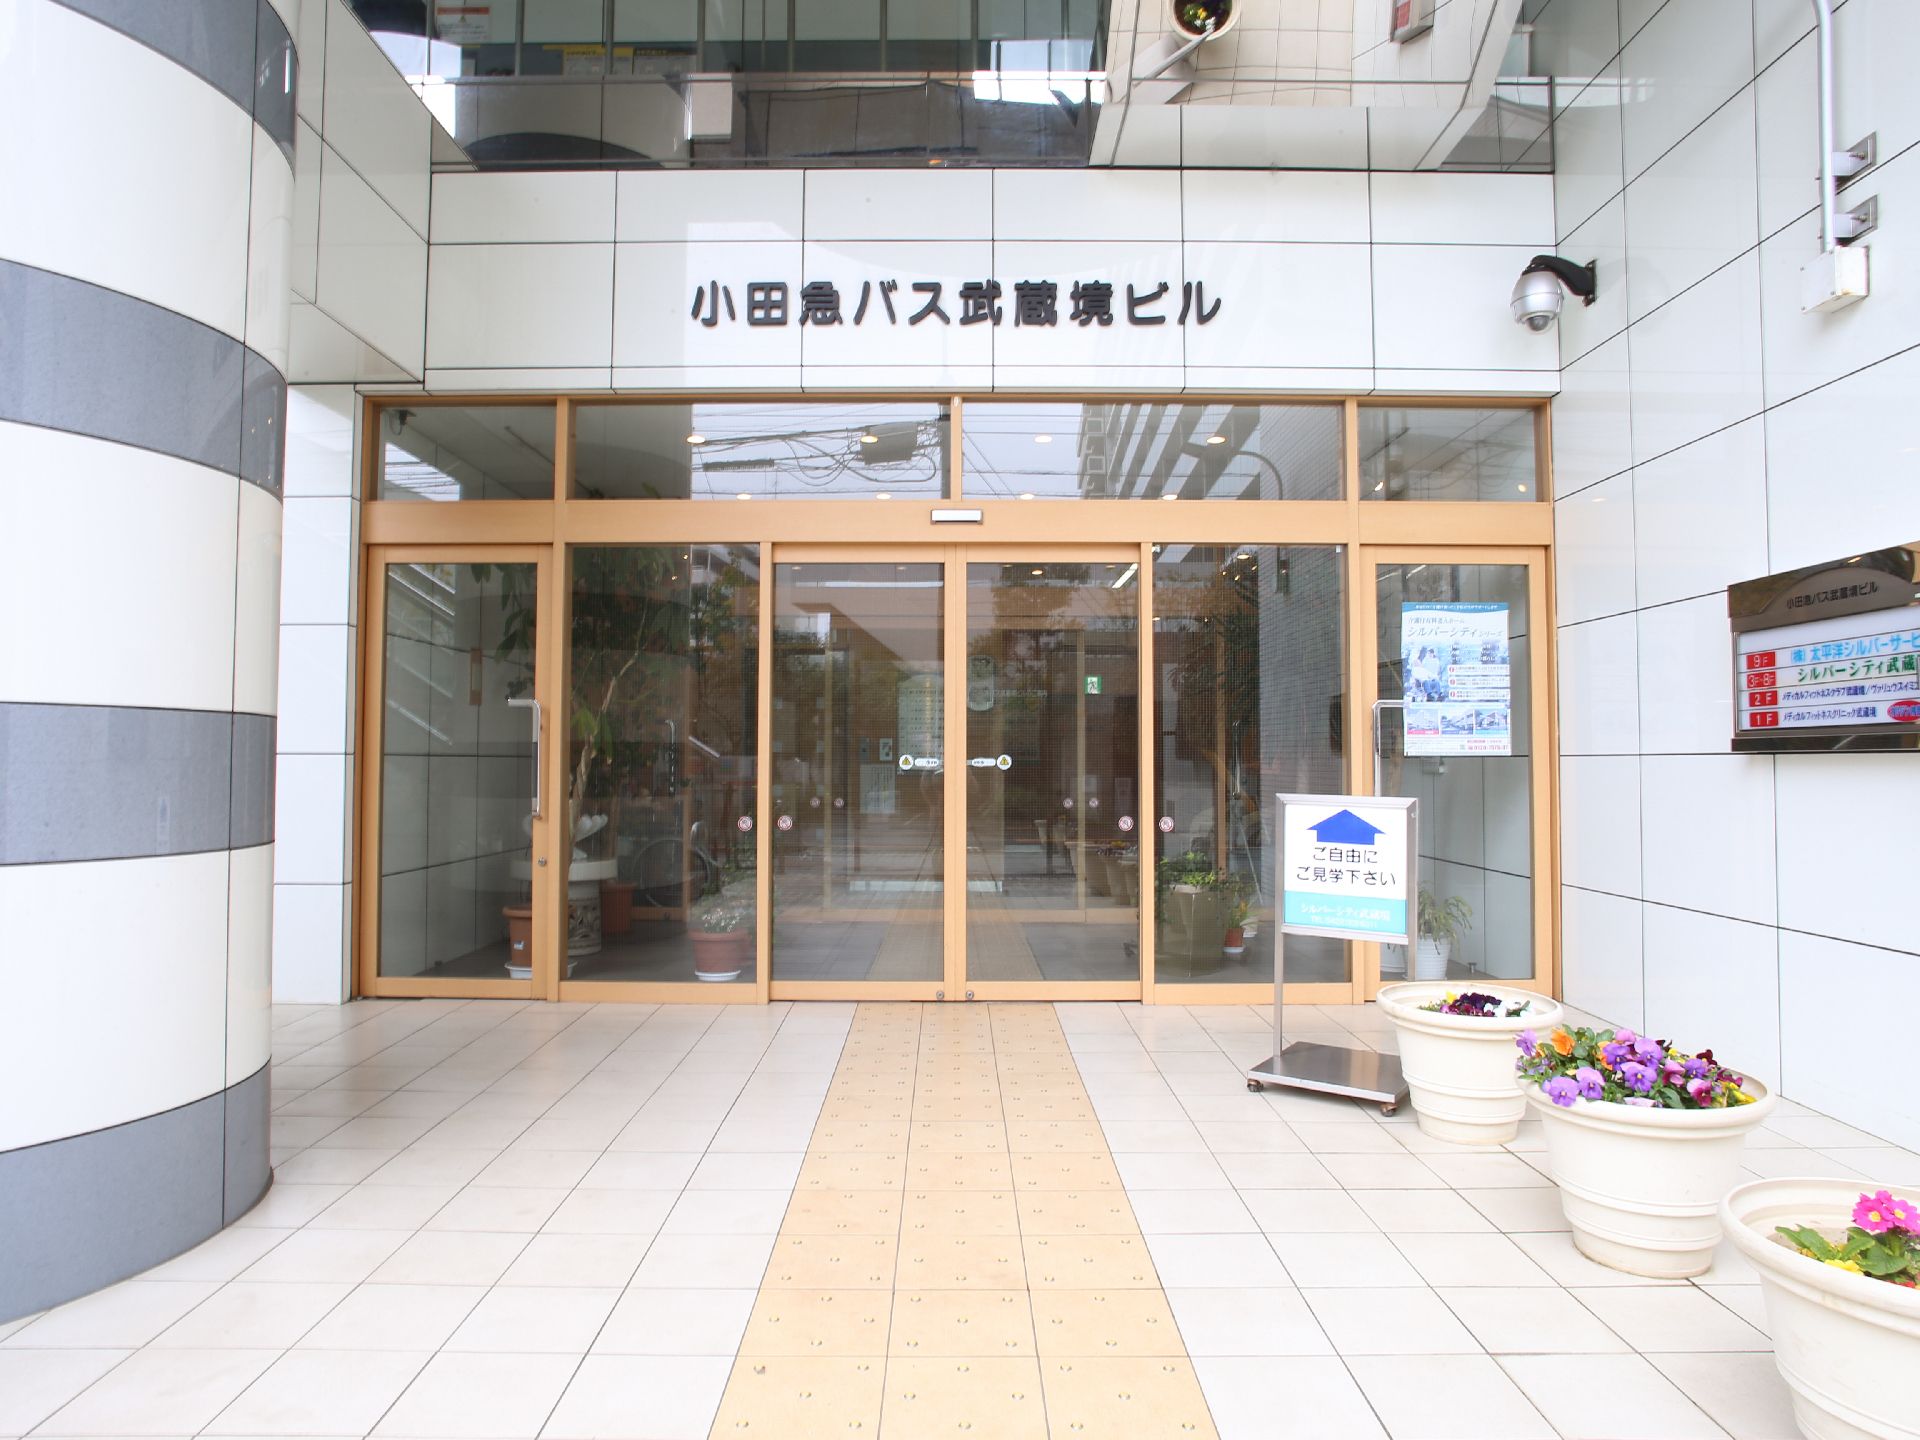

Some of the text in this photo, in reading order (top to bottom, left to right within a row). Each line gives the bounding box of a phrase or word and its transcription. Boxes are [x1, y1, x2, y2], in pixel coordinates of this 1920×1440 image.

[691, 280, 1222, 327] 小田急バス武蔵境ビル
[1753, 655, 1768, 668] 9F
[1754, 693, 1772, 705] 2F
[1756, 713, 1773, 726] 1F
[1313, 847, 1378, 864] ご自由に
[1296, 866, 1396, 886] ご見学下さい
